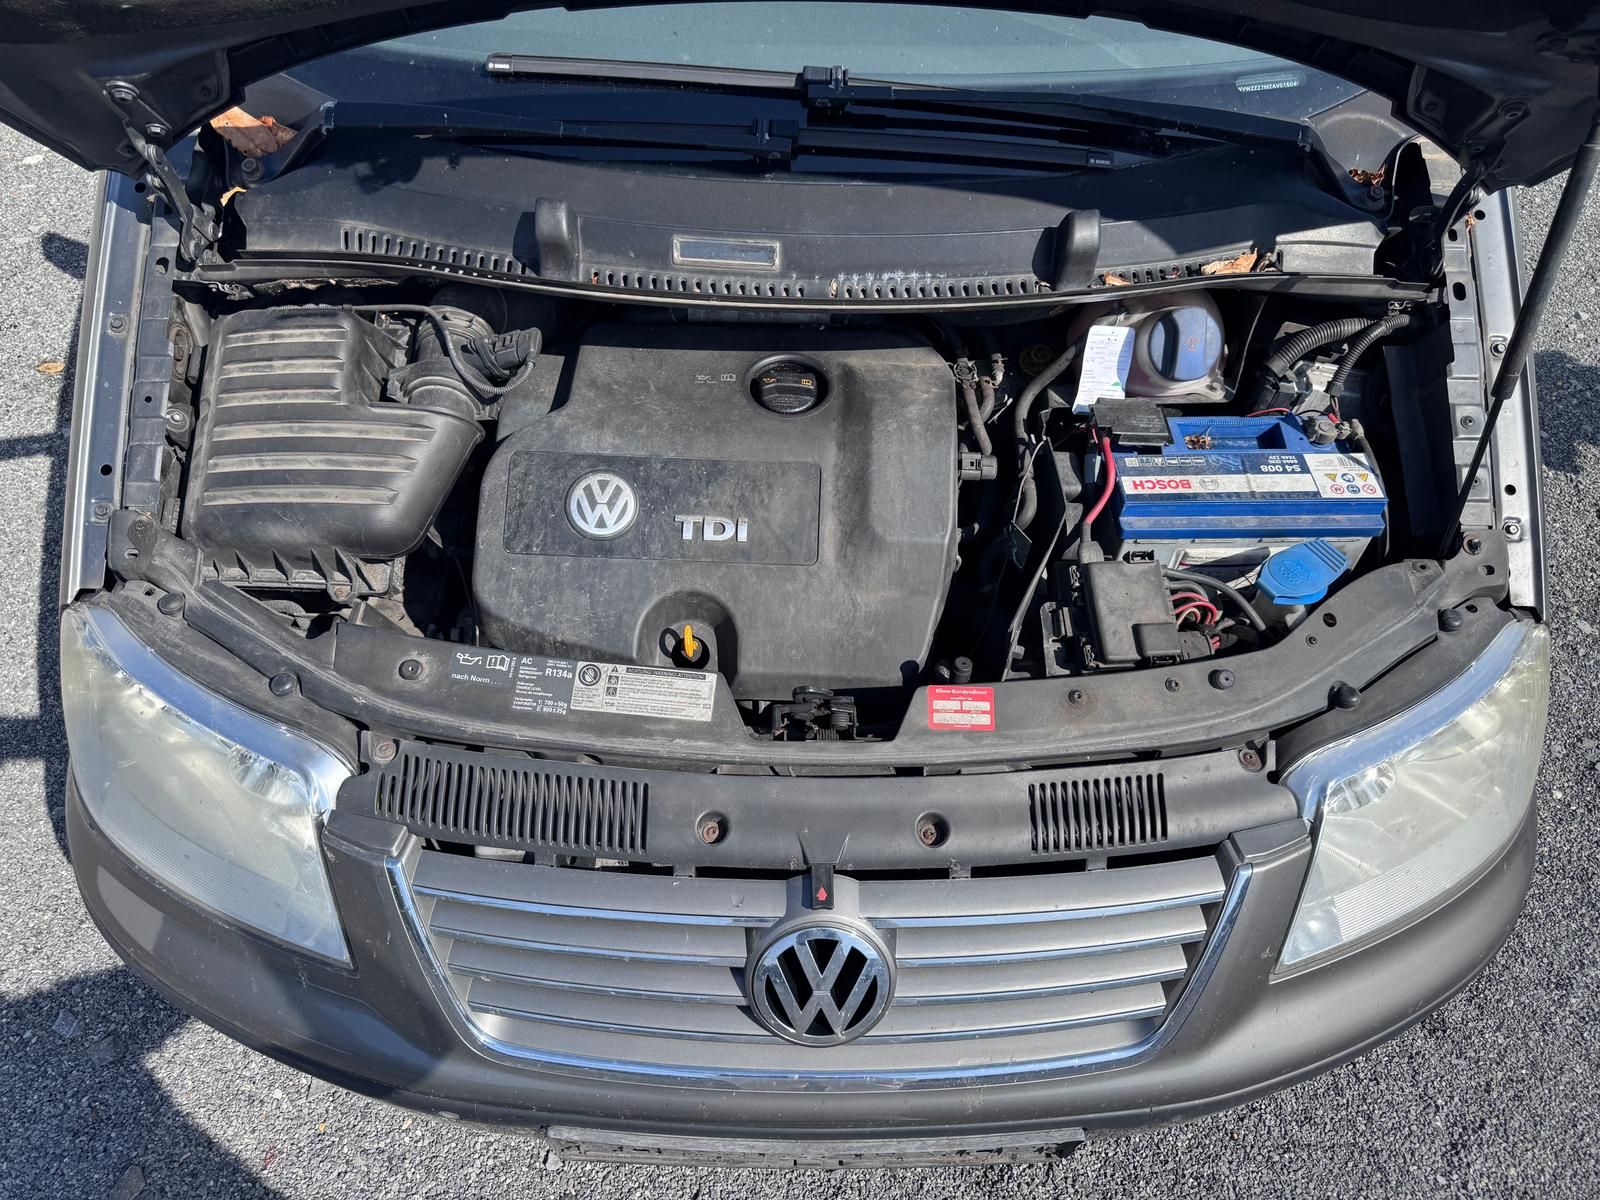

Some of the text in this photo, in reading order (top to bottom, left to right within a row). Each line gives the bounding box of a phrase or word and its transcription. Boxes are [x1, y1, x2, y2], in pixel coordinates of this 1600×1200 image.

[1260, 464, 1301, 473] S4 008
[1132, 479, 1192, 490] BOSCH
[569, 472, 636, 536] VW
[674, 515, 748, 542] TDI
[521, 657, 533, 665] AC
[545, 667, 573, 679] R134a
[752, 926, 891, 1047] VW
